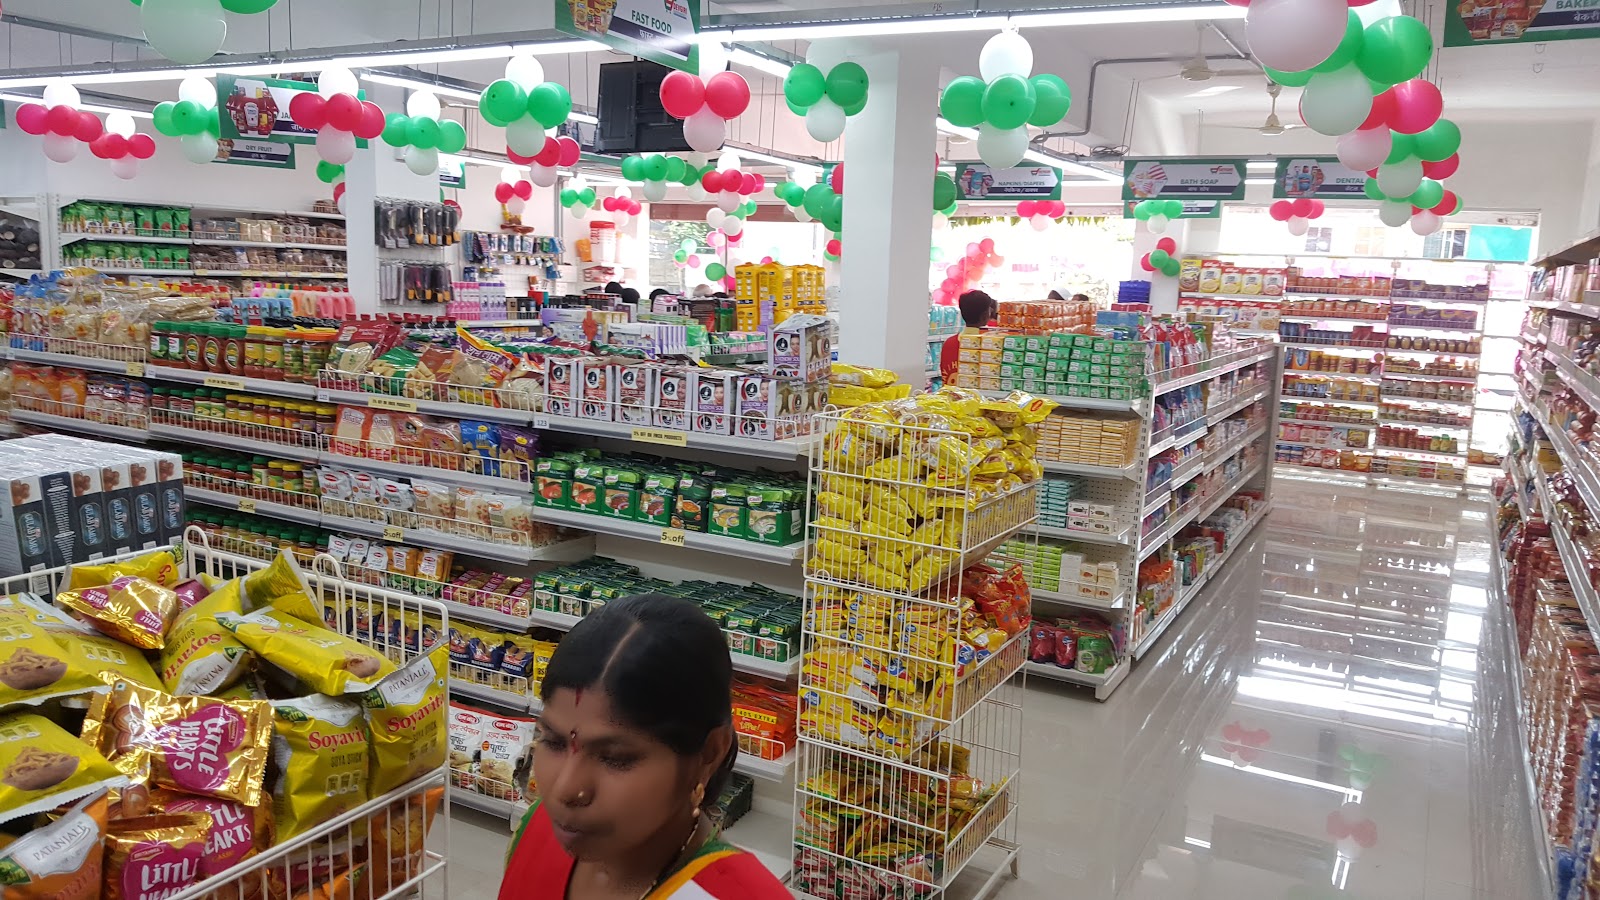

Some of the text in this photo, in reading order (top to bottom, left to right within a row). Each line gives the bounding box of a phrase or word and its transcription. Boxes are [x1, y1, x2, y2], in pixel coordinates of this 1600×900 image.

[631, 10, 672, 33] FAST FOOD
[739, 710, 775, 724] 40% EXTRA
[173, 720, 202, 772] HEARTS
